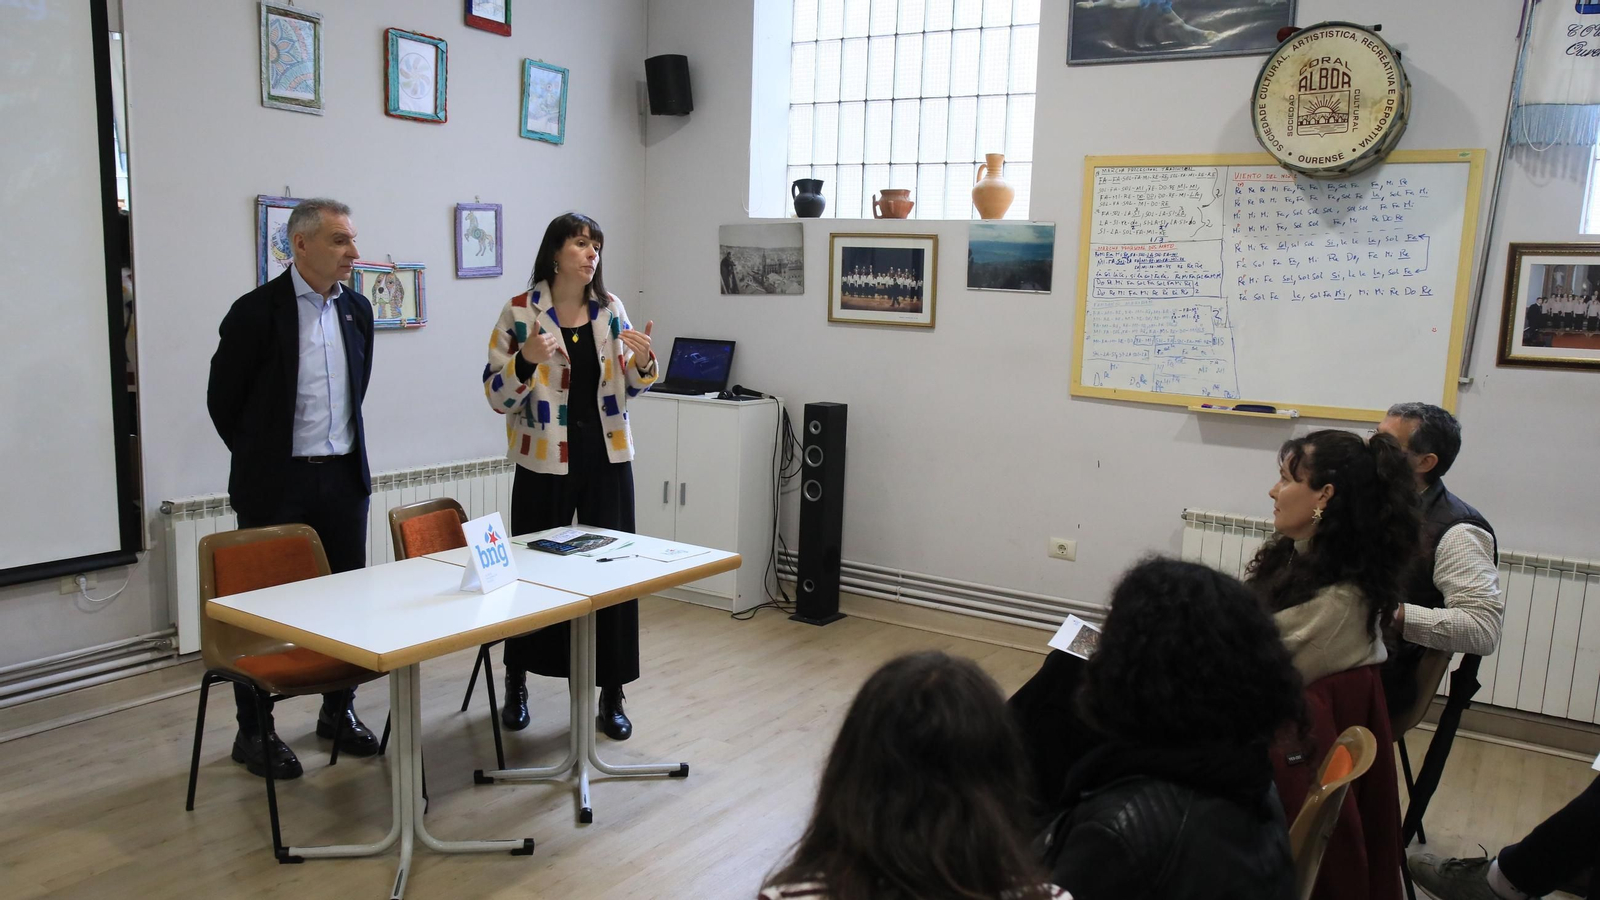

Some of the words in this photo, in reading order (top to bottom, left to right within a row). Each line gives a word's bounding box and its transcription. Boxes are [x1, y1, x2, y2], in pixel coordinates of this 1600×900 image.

[1292, 30, 1358, 52] ARTISTISTICA,
[1361, 37, 1395, 87] RECREATIVA
[1260, 54, 1290, 100] CULTURAL,
[1300, 56, 1352, 76] CORAL
[1258, 104, 1284, 152] SOCIEDADE
[1286, 94, 1295, 137] SOCIEDAD
[1352, 89, 1360, 133] CULTURAL
[1358, 99, 1395, 148] DEPORTIVA
[1298, 152, 1345, 164] OURENSE
[475, 542, 509, 569] bng
